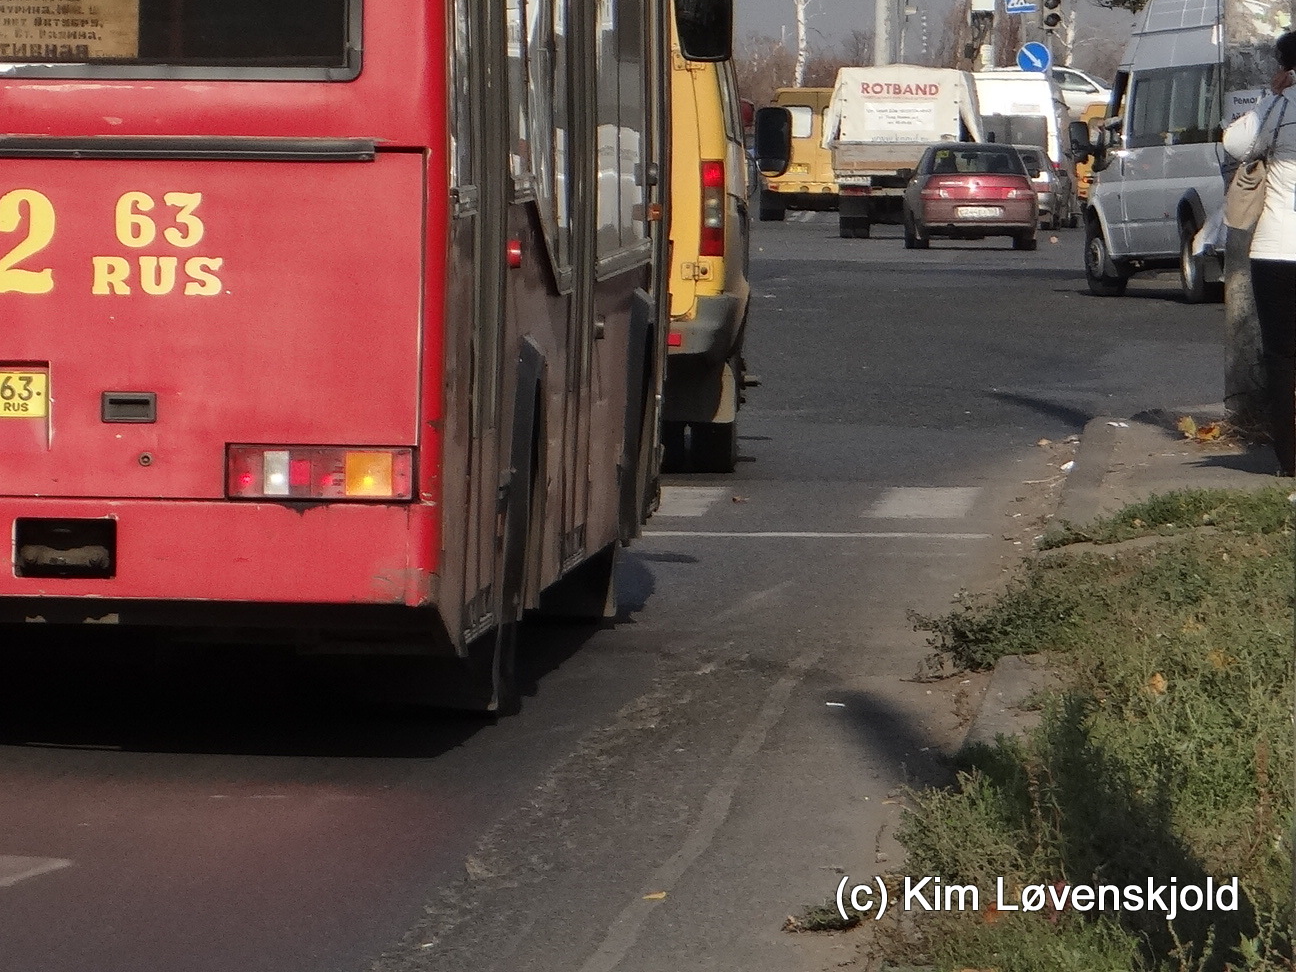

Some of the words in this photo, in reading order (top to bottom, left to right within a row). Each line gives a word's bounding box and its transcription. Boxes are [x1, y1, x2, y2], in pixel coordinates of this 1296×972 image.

[860, 82, 939, 96] ROTBAND
[115, 191, 205, 248] 63
[92, 256, 223, 296] RUS
[0, 376, 34, 401] 63
[4, 402, 29, 412] RUS
